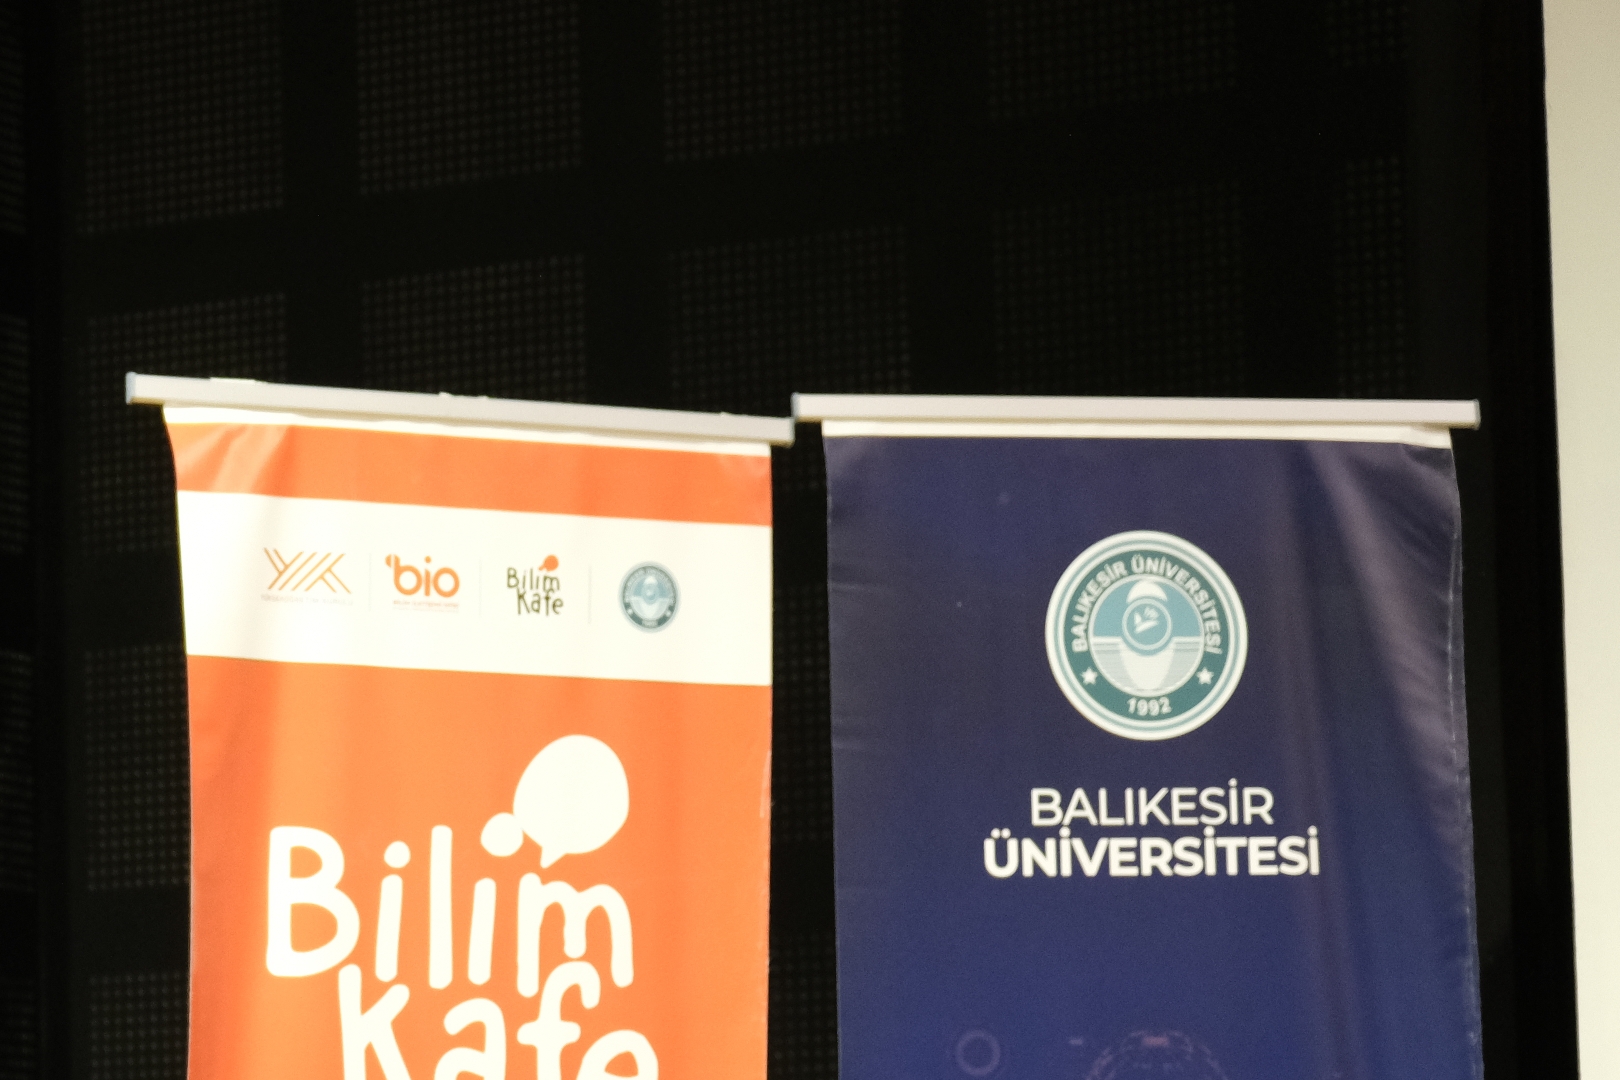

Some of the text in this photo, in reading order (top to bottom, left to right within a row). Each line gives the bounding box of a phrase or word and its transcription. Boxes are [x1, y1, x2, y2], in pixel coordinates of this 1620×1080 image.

[507, 566, 561, 593] Bilim
[516, 587, 565, 617] Kafe
[1071, 553, 1223, 655] BALIKESİR ÜNİVERSİTESİ
[1127, 697, 1172, 716] 1992
[1030, 777, 1274, 827] BALIKESİR
[983, 826, 1320, 879] ÜNİVERSİTESİ
[266, 824, 634, 998] Bilim
